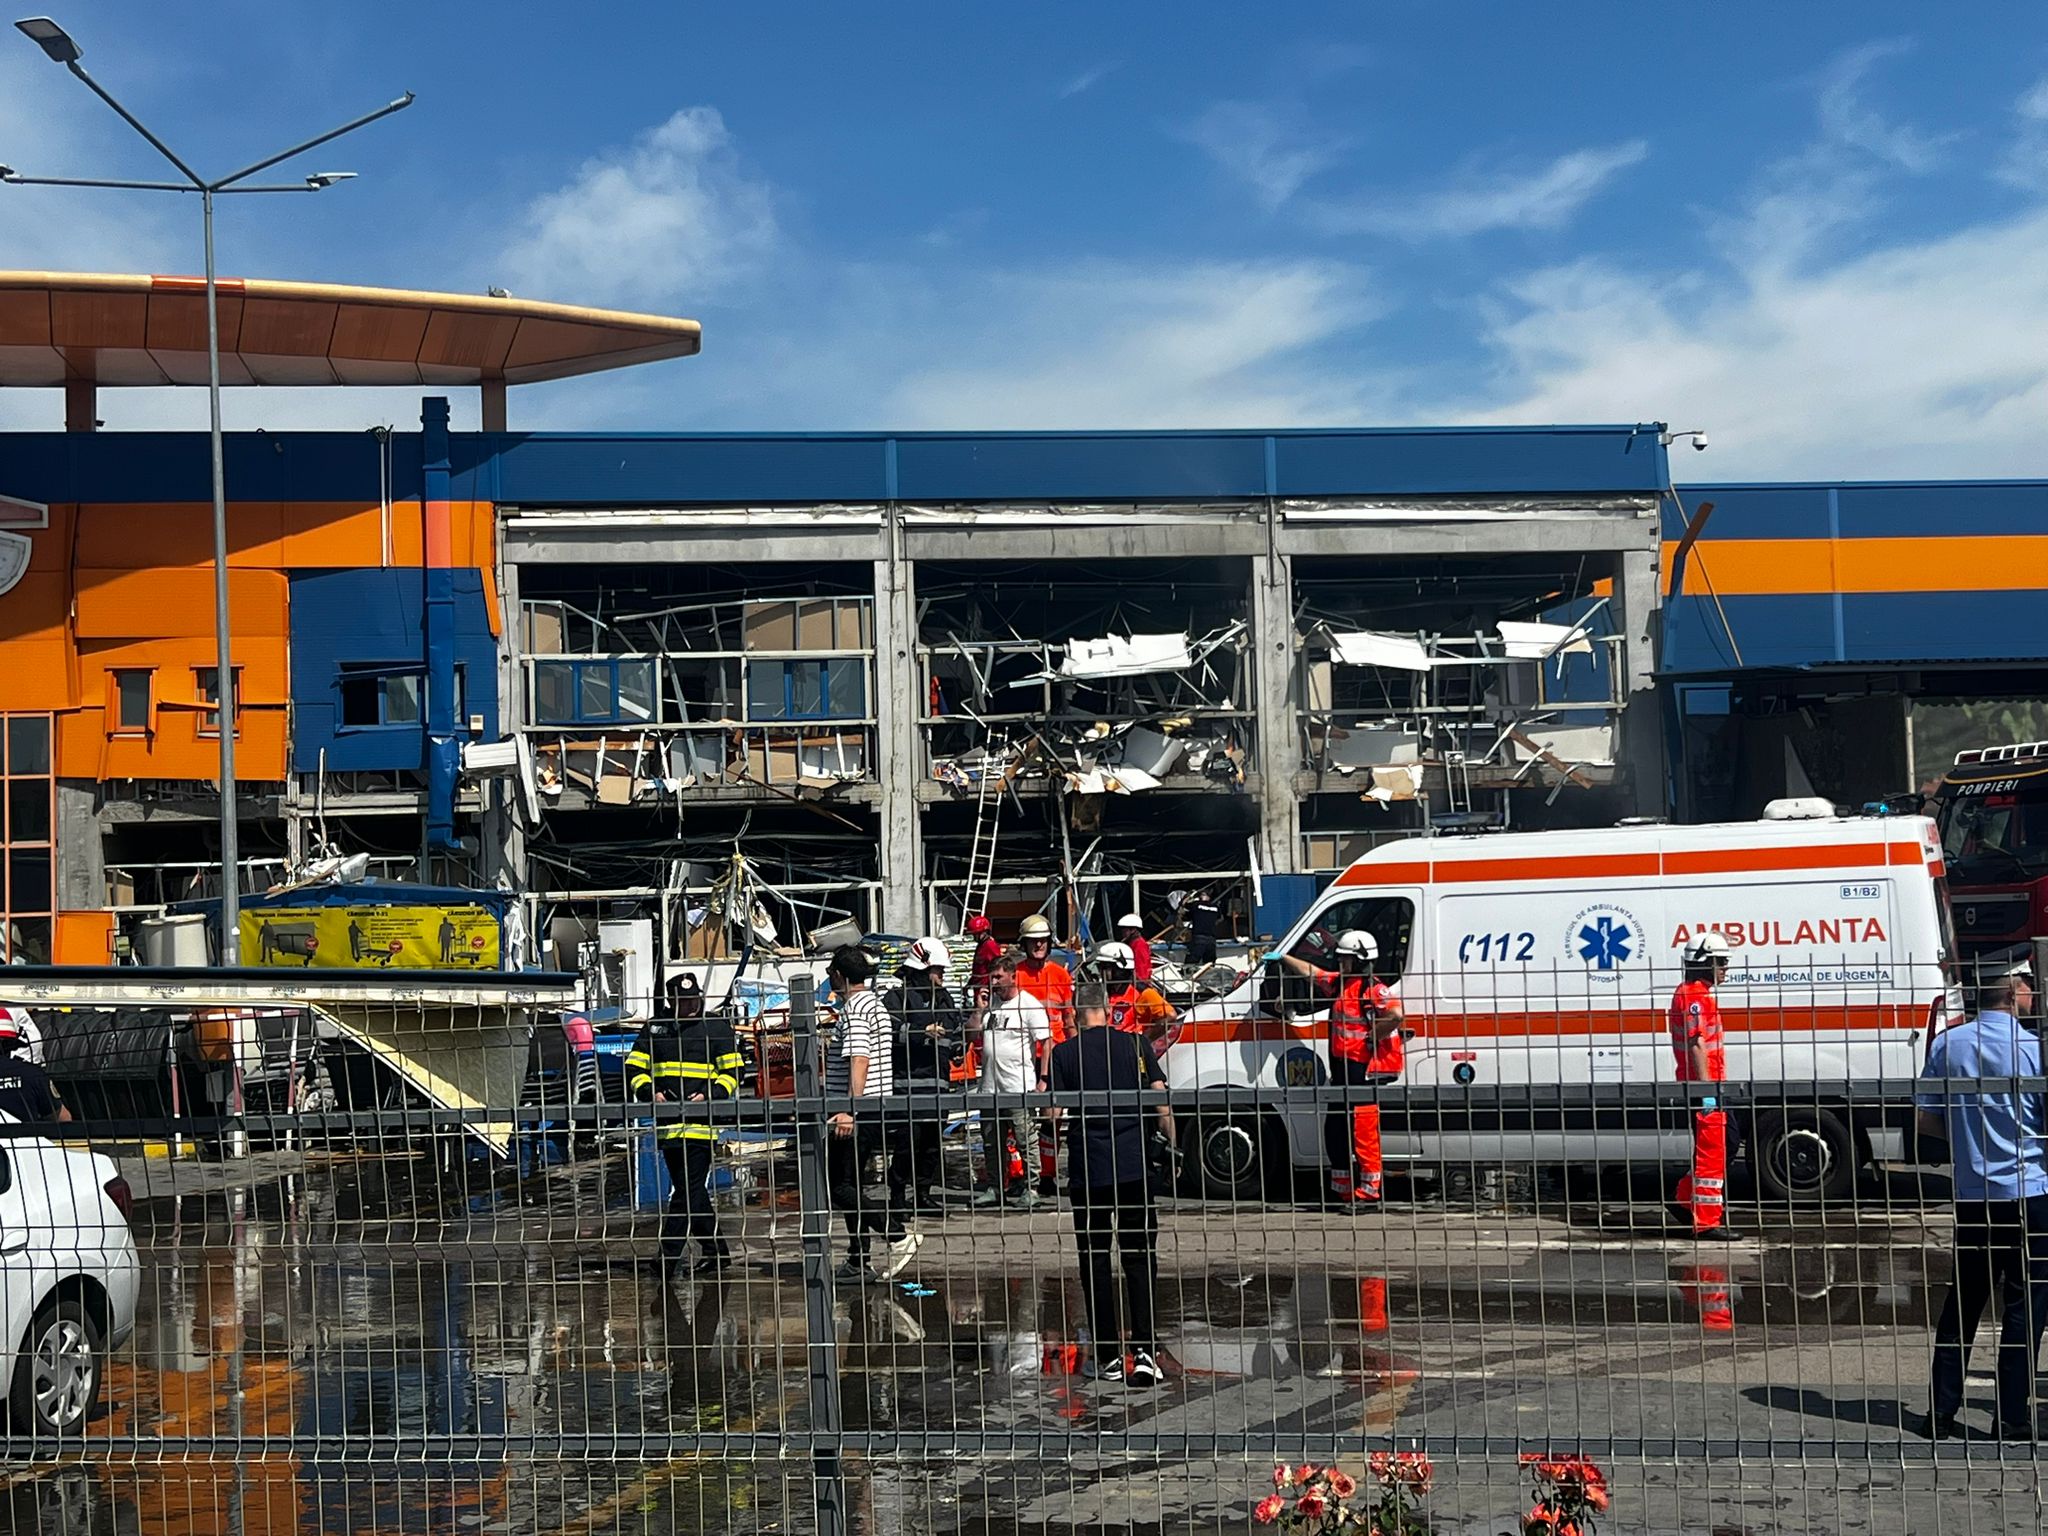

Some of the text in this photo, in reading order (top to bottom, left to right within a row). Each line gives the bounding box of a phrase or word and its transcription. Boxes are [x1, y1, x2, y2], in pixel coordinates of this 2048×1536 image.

[1957, 780, 2019, 795] POMPIERI
[1587, 903, 1633, 920] AMBULANTA
[1764, 971, 1812, 982] MEDICAL
[1816, 971, 1832, 981] DE
[1835, 970, 1889, 981] URGENTA
